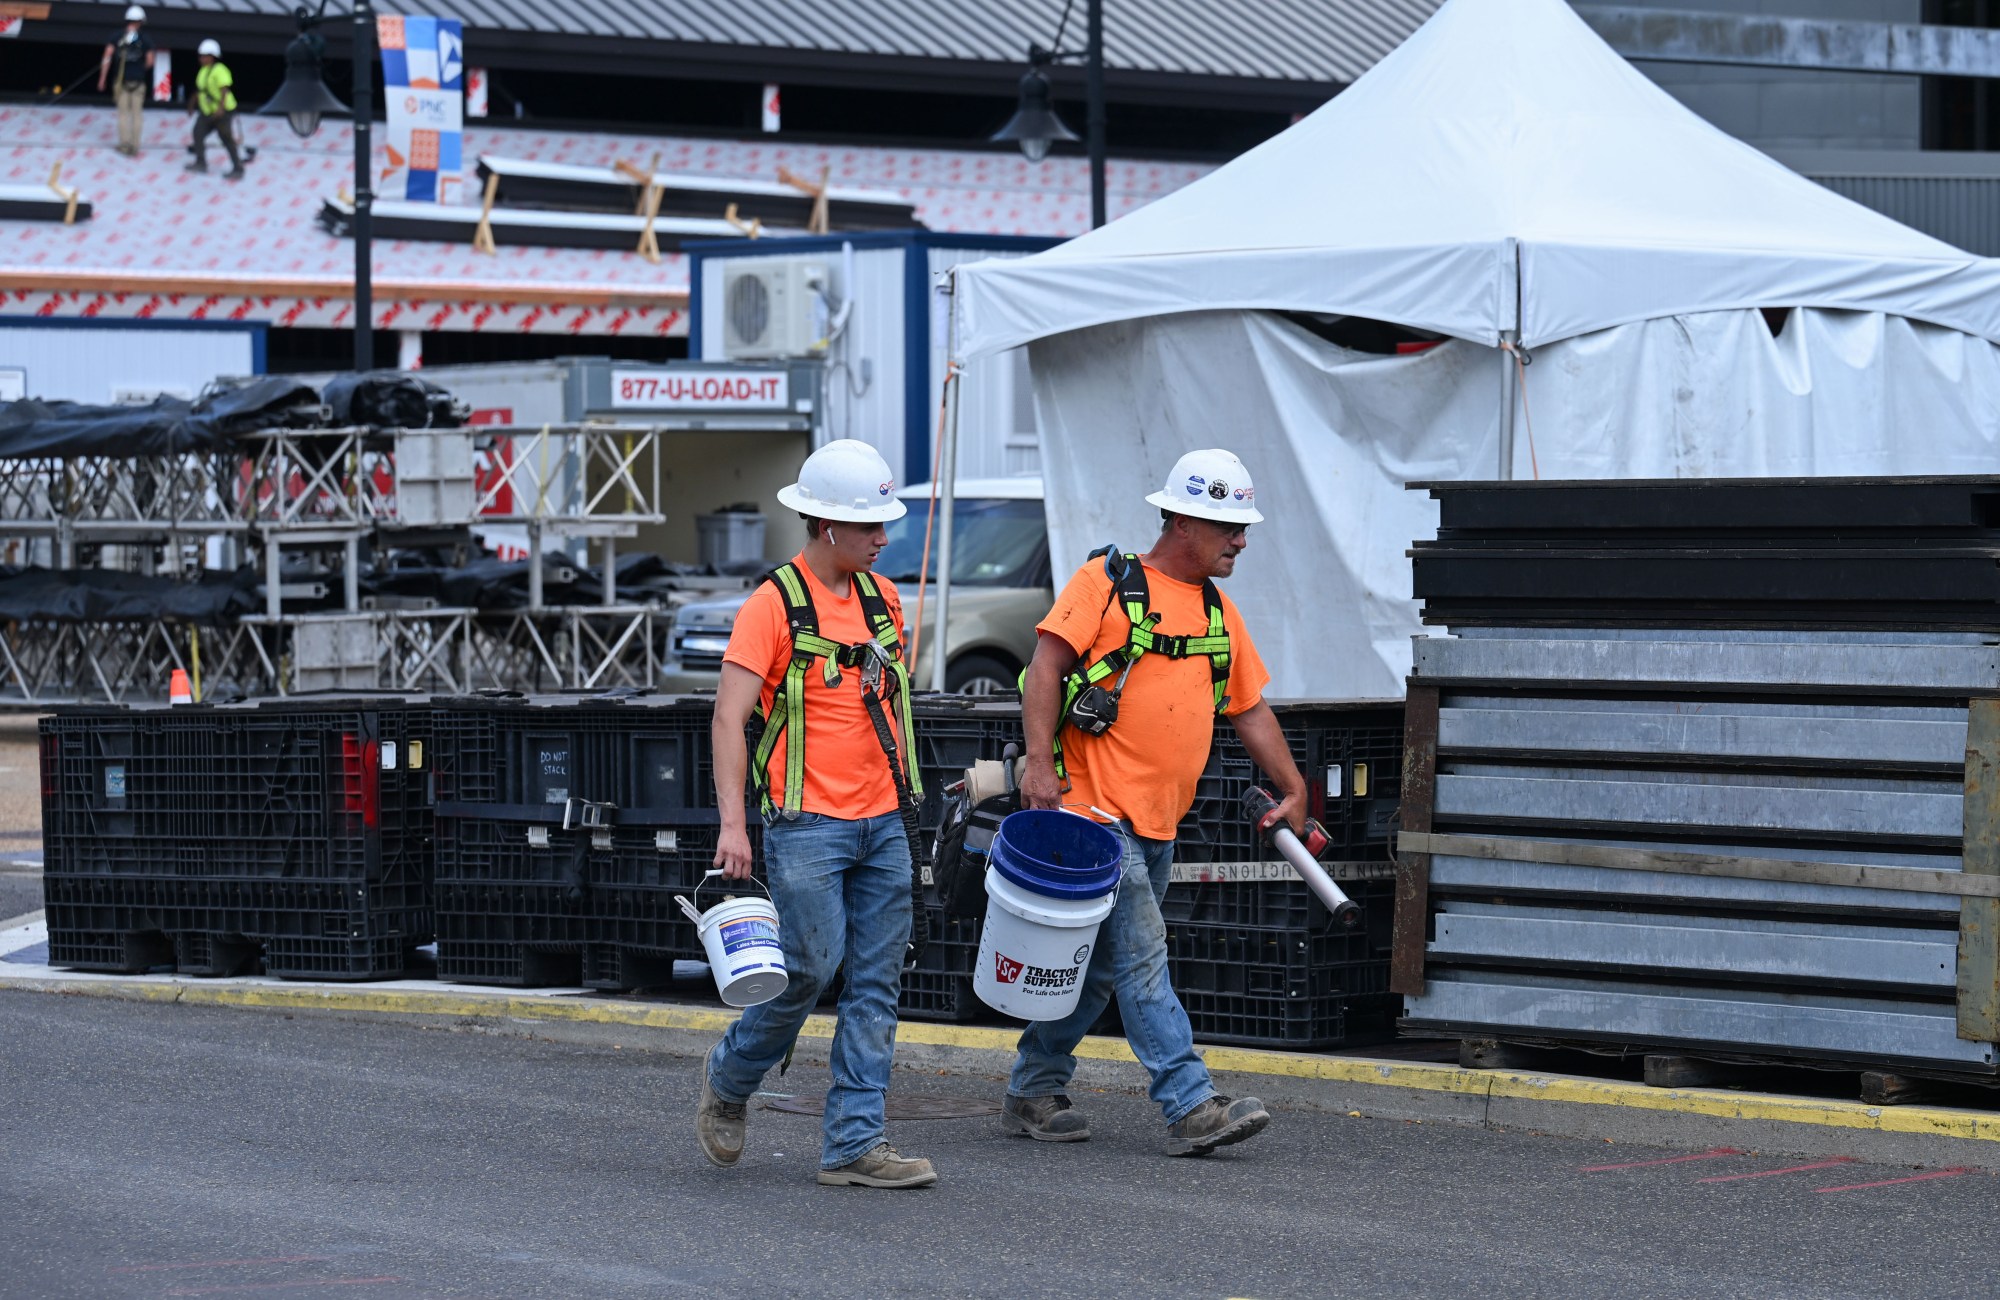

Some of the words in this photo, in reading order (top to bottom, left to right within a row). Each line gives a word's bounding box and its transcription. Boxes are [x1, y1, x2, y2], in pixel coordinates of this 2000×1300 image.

[621, 378, 779, 400] 877-U-LOAD-IT
[540, 751, 551, 763] DO
[553, 751, 568, 761] NOT
[544, 765, 566, 775] STACK
[997, 955, 1017, 982] TSC
[1027, 965, 1079, 978] TRACTOR
[1024, 975, 1067, 987] SUPPLY
[1022, 987, 1034, 995] For
[1061, 988, 1074, 996] Here
